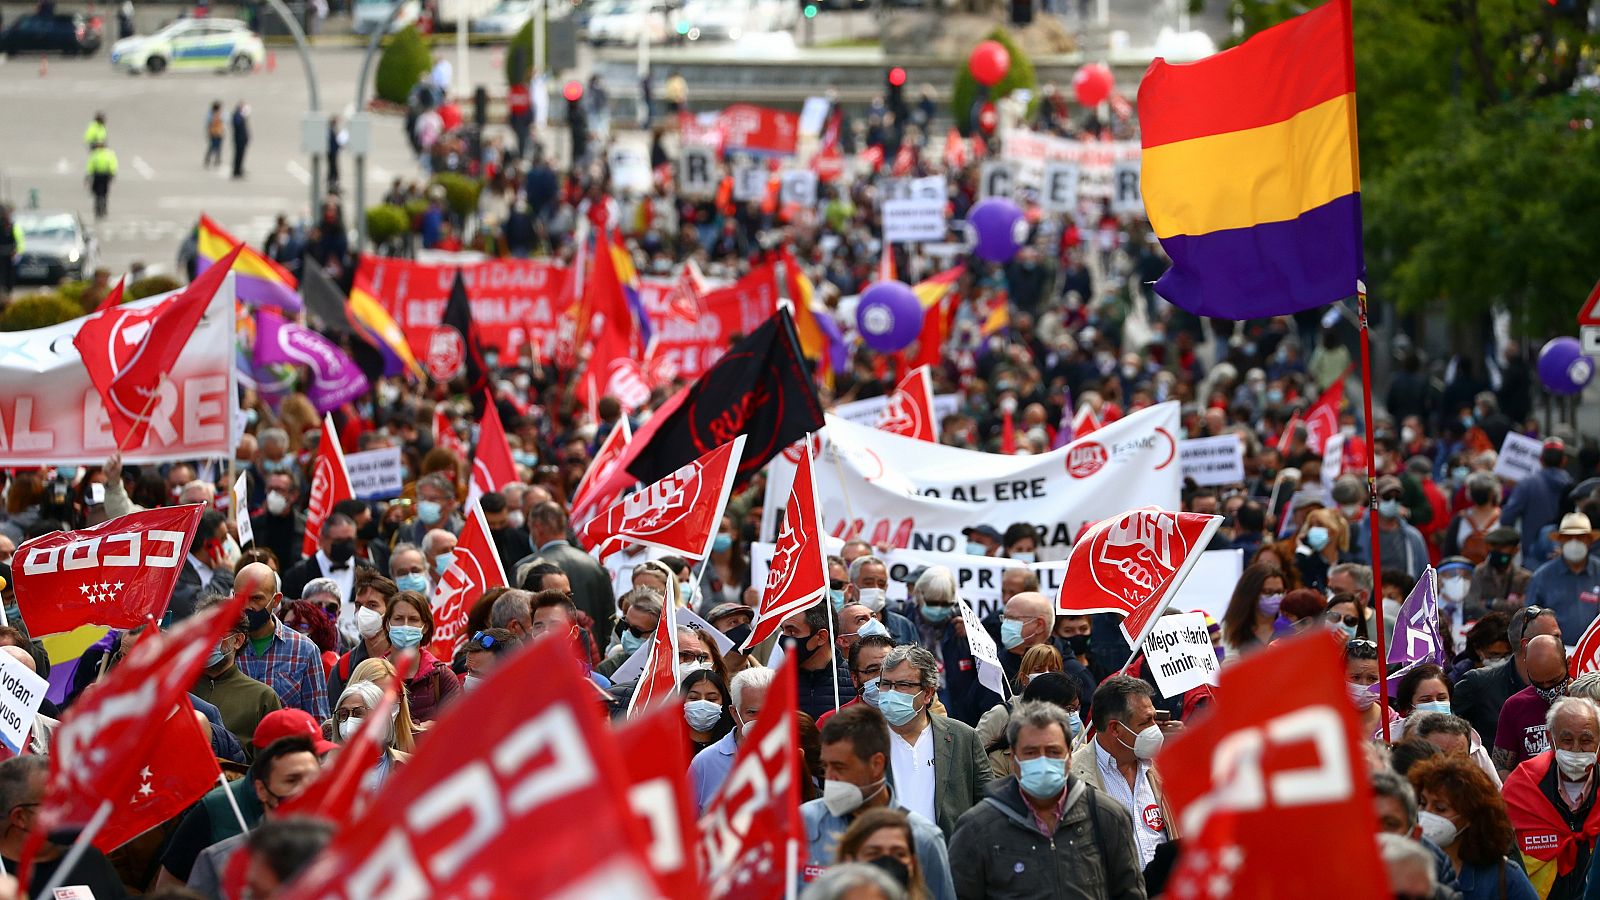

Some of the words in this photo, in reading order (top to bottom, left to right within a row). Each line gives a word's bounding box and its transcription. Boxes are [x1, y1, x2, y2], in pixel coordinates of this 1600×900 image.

[952, 486, 987, 503] AL
[994, 476, 1047, 500] ERE
[912, 532, 956, 553] NO
[1107, 511, 1175, 570] UGT
[1143, 630, 1179, 658] ¡Mejor
[2, 671, 34, 707] votan:
[1144, 805, 1163, 821] UGT
[1524, 834, 1558, 845] CCOO
